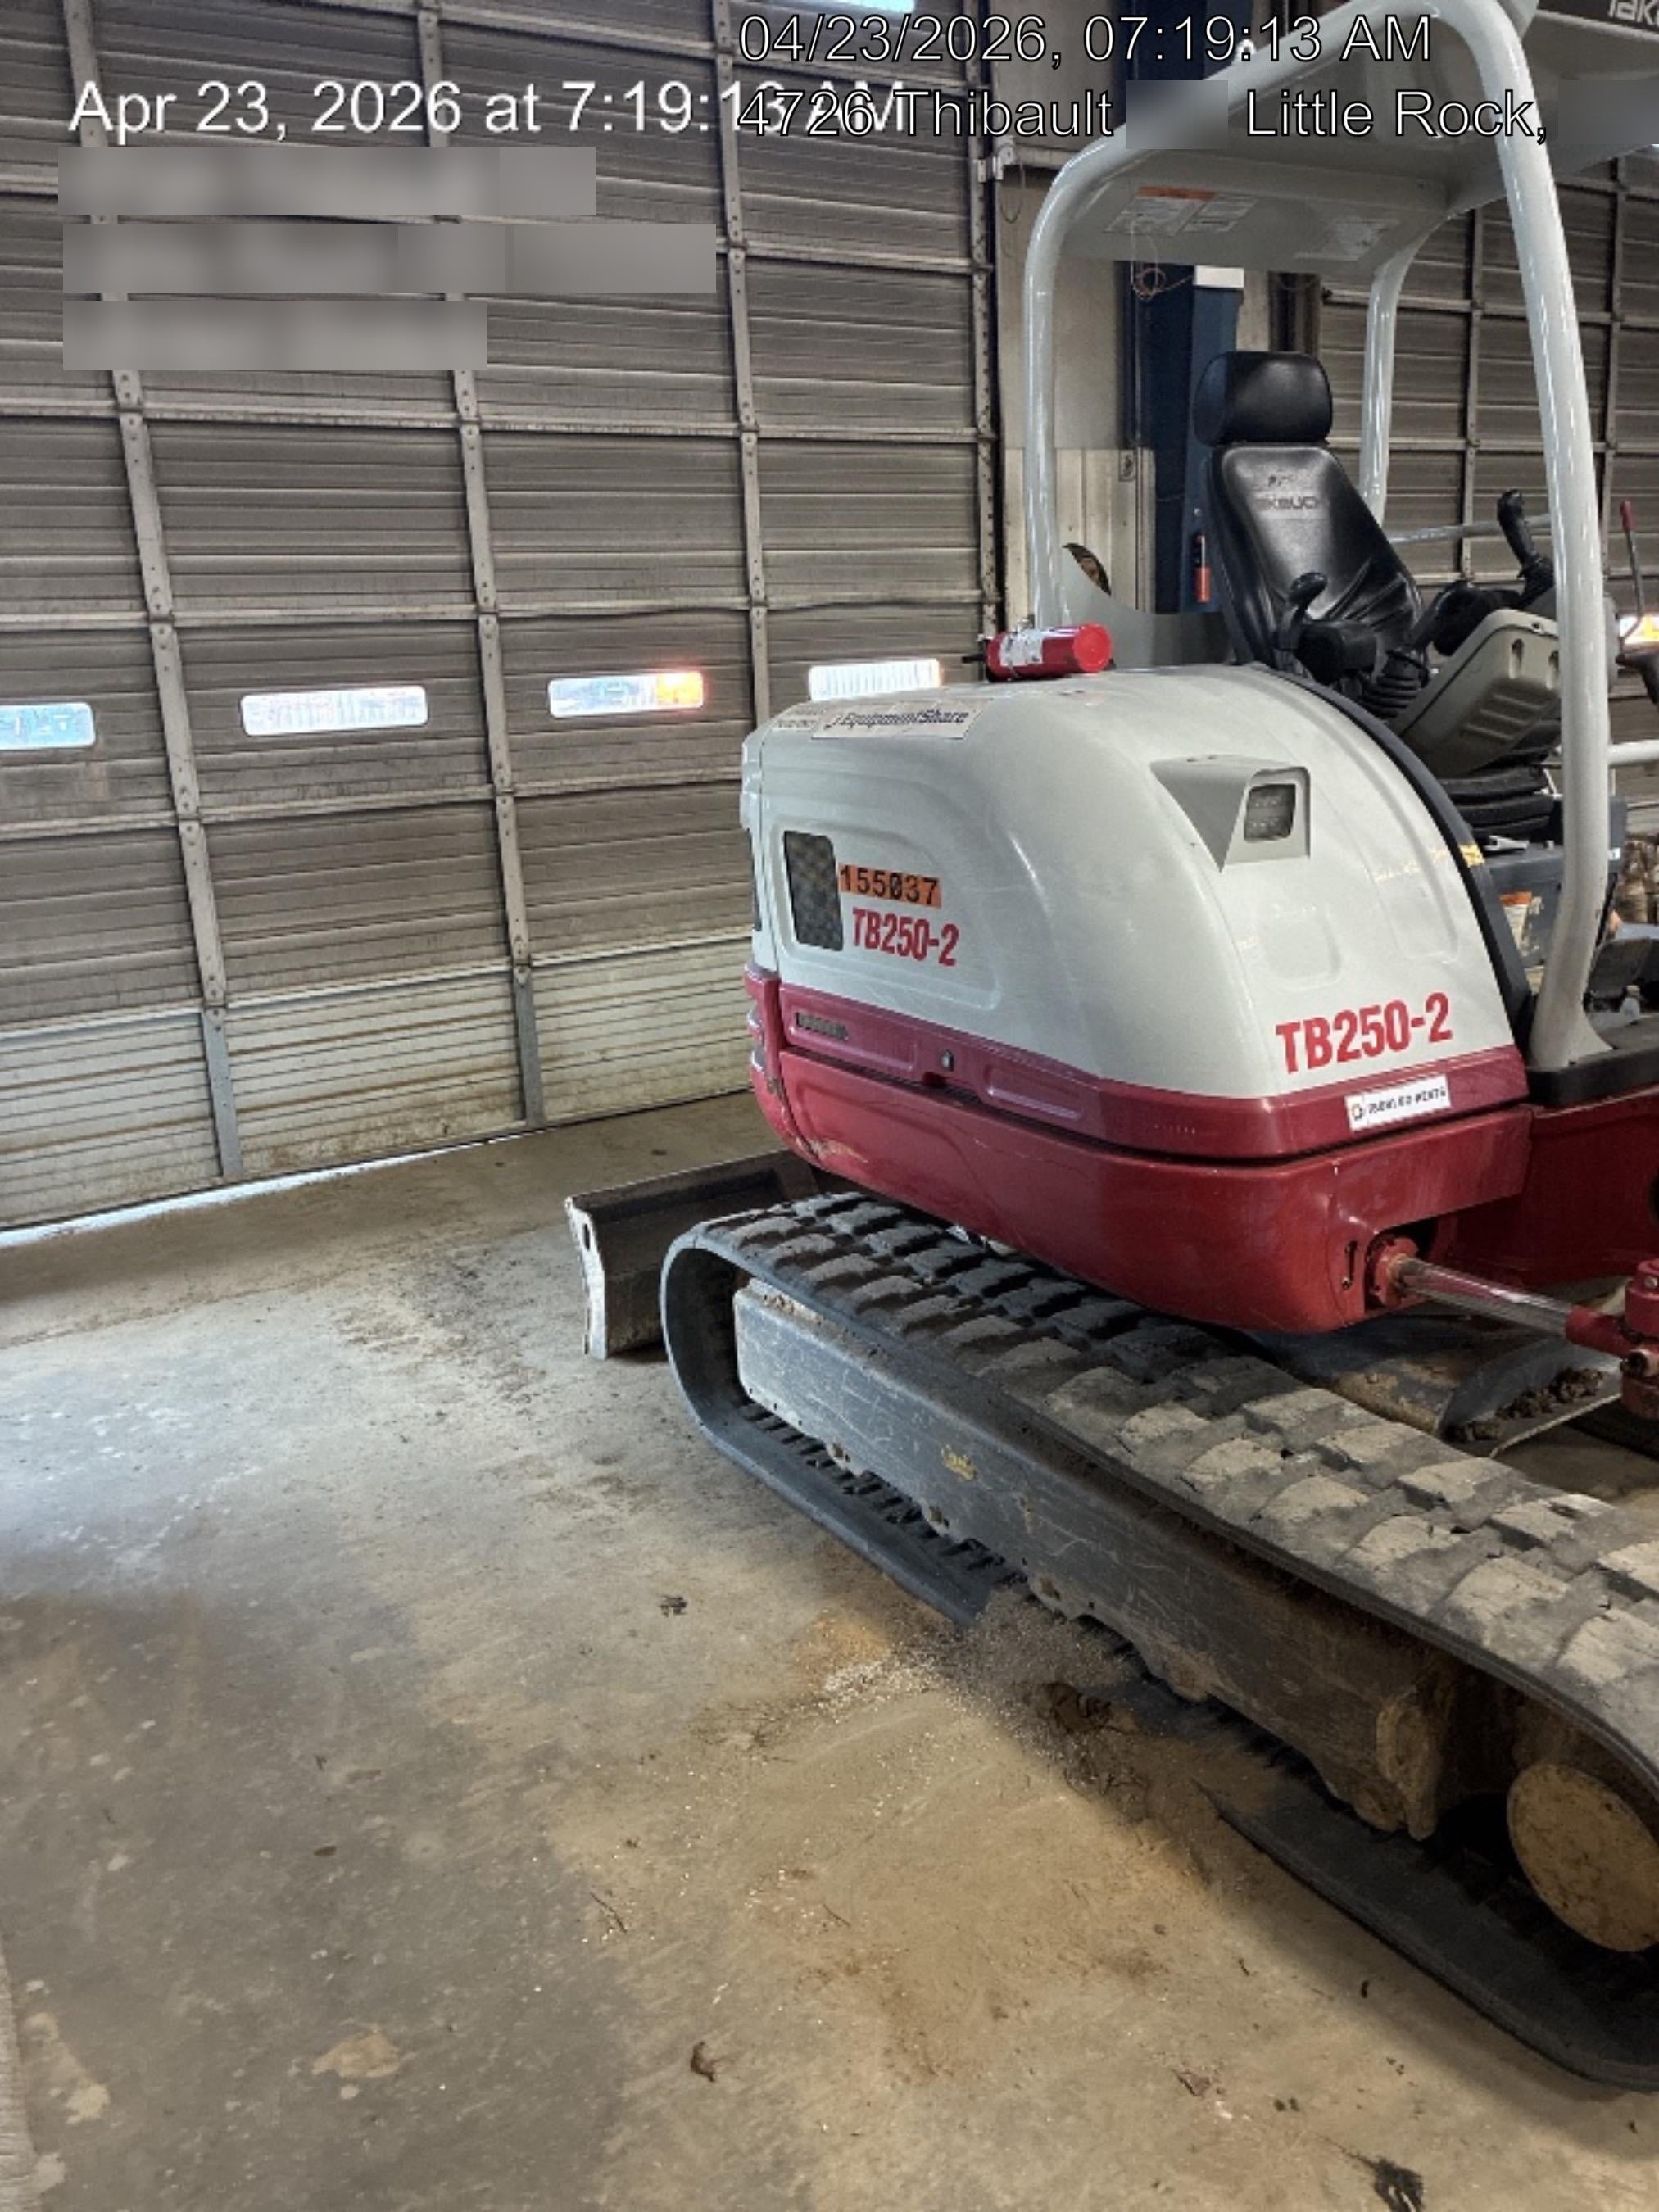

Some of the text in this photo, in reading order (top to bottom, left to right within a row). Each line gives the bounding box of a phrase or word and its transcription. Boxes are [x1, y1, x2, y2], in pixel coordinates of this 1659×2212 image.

[839, 865, 941, 906] 155037
[852, 907, 959, 966] TB250-2
[1275, 991, 1453, 1075] TB250-2
